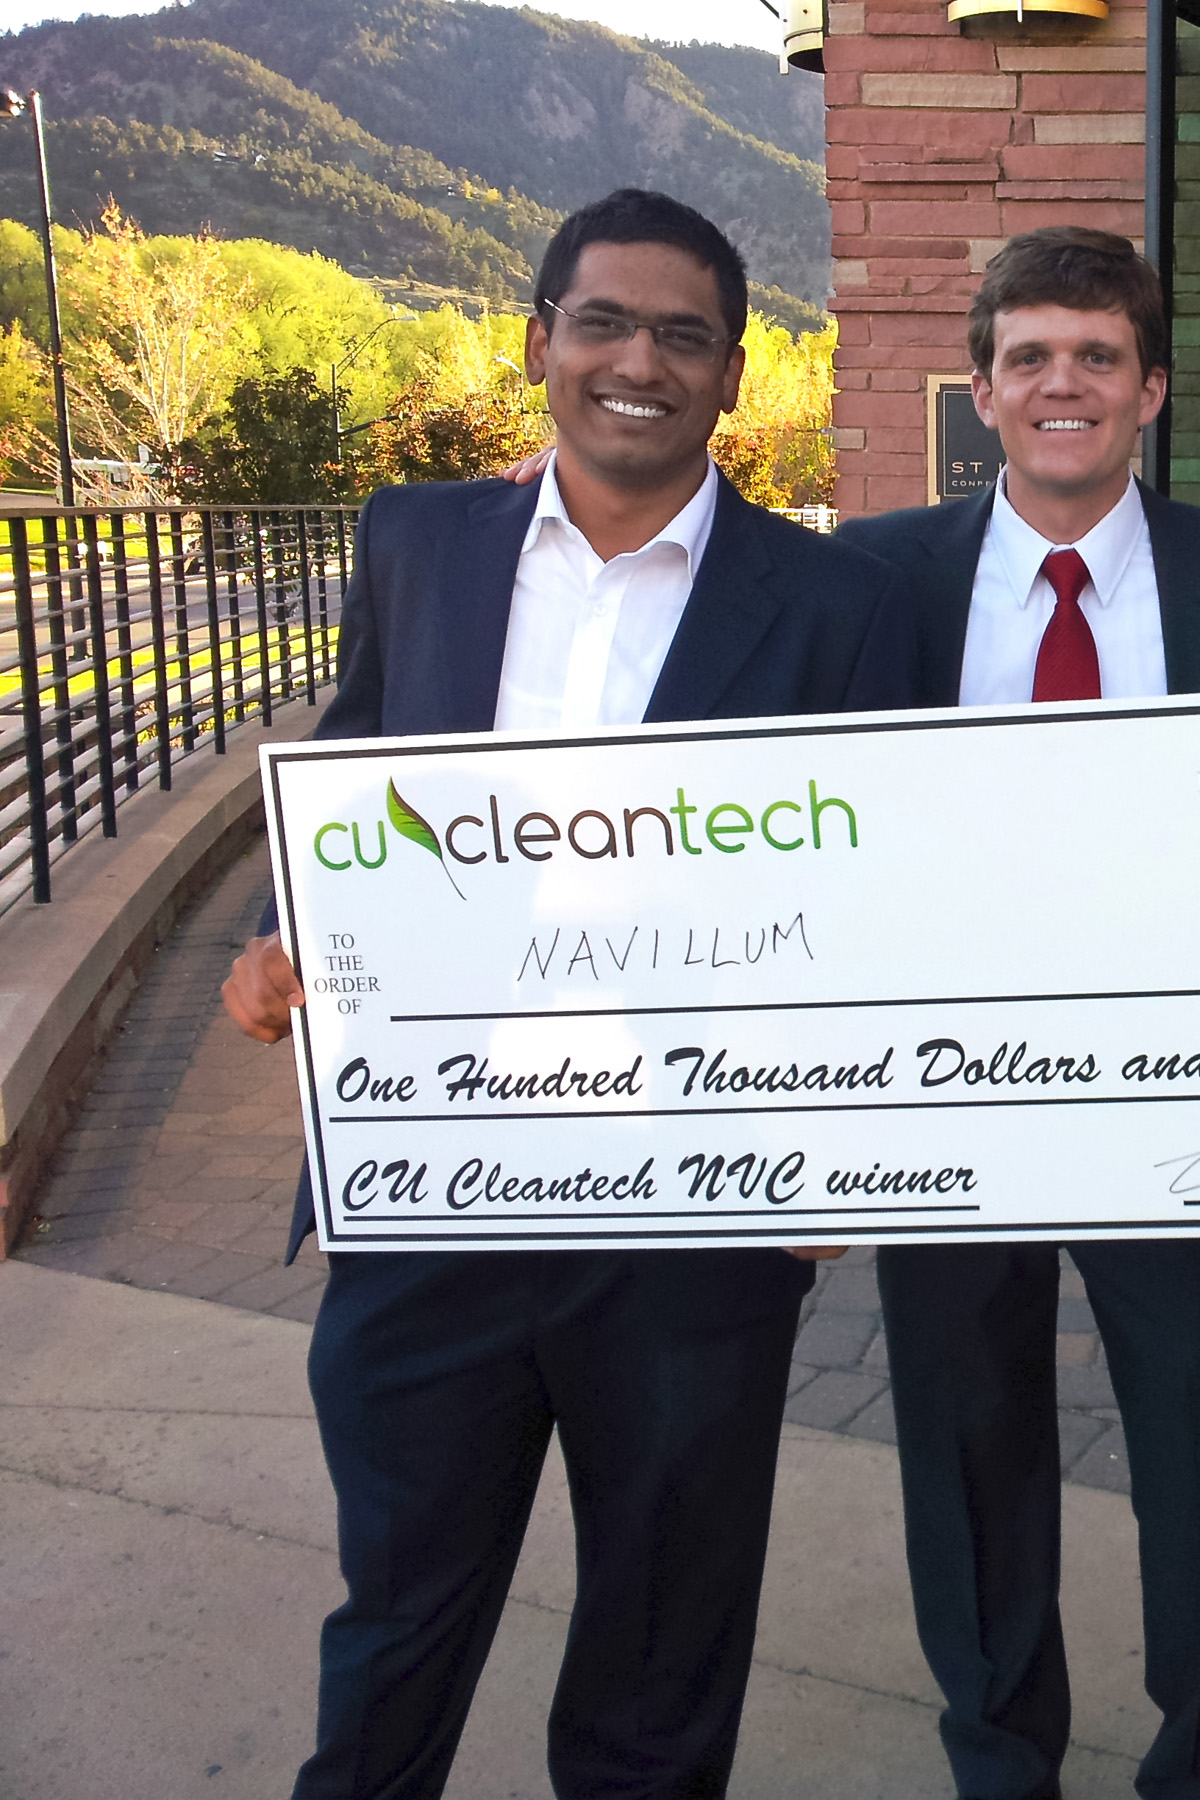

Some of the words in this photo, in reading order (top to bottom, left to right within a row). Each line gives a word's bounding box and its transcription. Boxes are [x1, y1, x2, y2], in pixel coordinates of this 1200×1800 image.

[951, 461, 983, 474] ST
[444, 779, 858, 864] cleantech
[328, 933, 355, 950] TO
[516, 911, 814, 982] NAVILLUM
[324, 955, 364, 972] THE
[314, 976, 382, 993] ORDER
[337, 998, 362, 1015] OF
[336, 1056, 418, 1103] One
[437, 1053, 643, 1102] Hundred
[664, 1046, 894, 1097] Thousand
[916, 1038, 1102, 1088] Dollars
[342, 1159, 429, 1212] CU
[446, 1156, 657, 1212] Cleantech
[677, 1150, 805, 1205] NVC
[825, 1162, 978, 1201] winner
